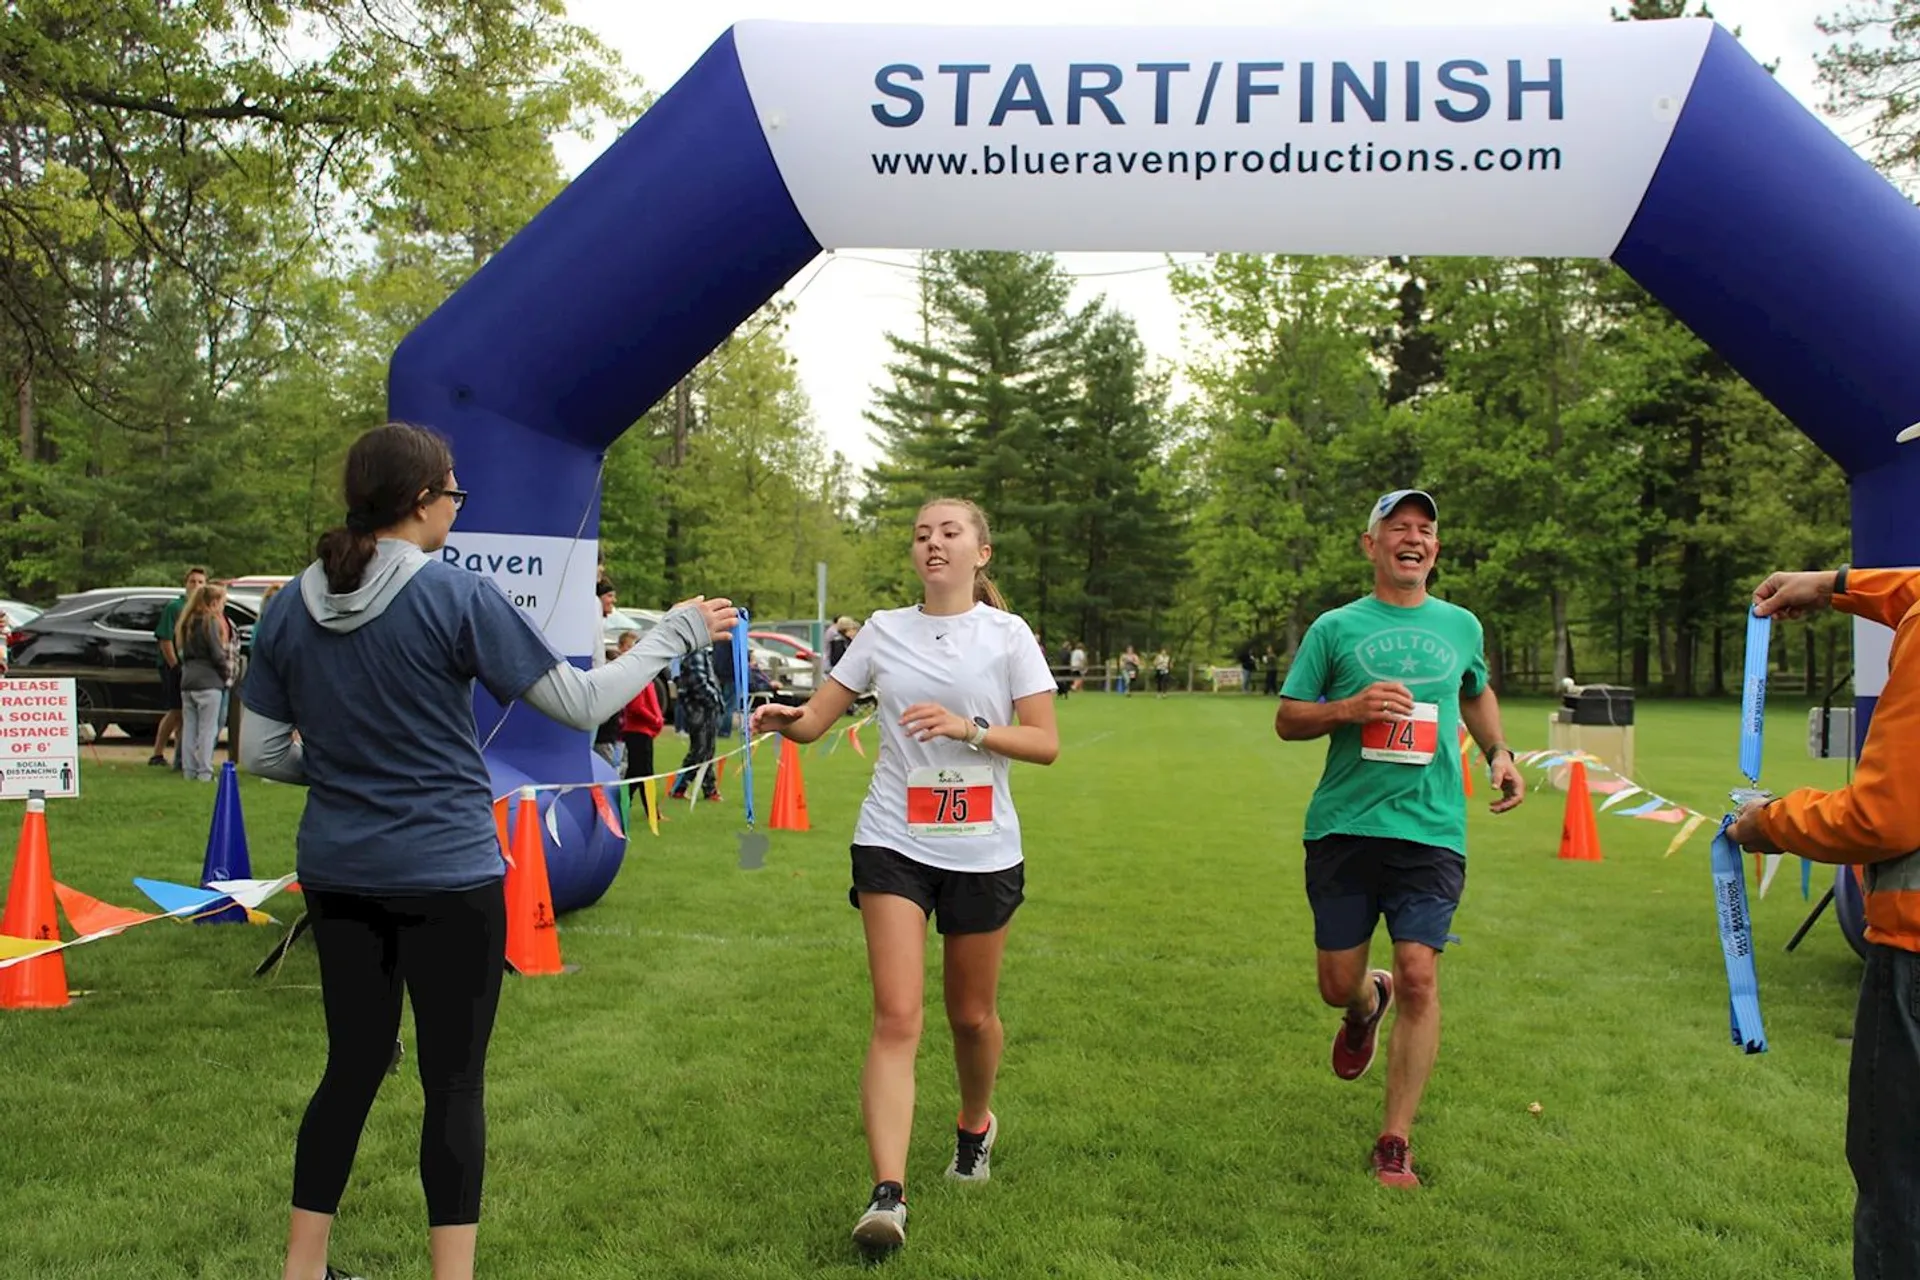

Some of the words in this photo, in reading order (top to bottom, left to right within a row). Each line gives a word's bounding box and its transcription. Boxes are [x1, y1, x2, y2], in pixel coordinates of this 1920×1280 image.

[871, 59, 1563, 127] START/FINISH
[871, 142, 1562, 180] www.blueravenproductions.com
[442, 545, 543, 576] Raven
[1365, 634, 1451, 665] FULTON
[0, 681, 59, 691] PLEASE
[0, 696, 68, 706] RACTICE
[9, 712, 67, 722] SOCIAL
[0, 727, 69, 737] ISTANCE
[1385, 720, 1414, 749] 74
[11, 743, 31, 753] OF
[933, 787, 968, 822] 75
[1727, 880, 1741, 932] MARATHON
[1734, 933, 1745, 957] HALF
